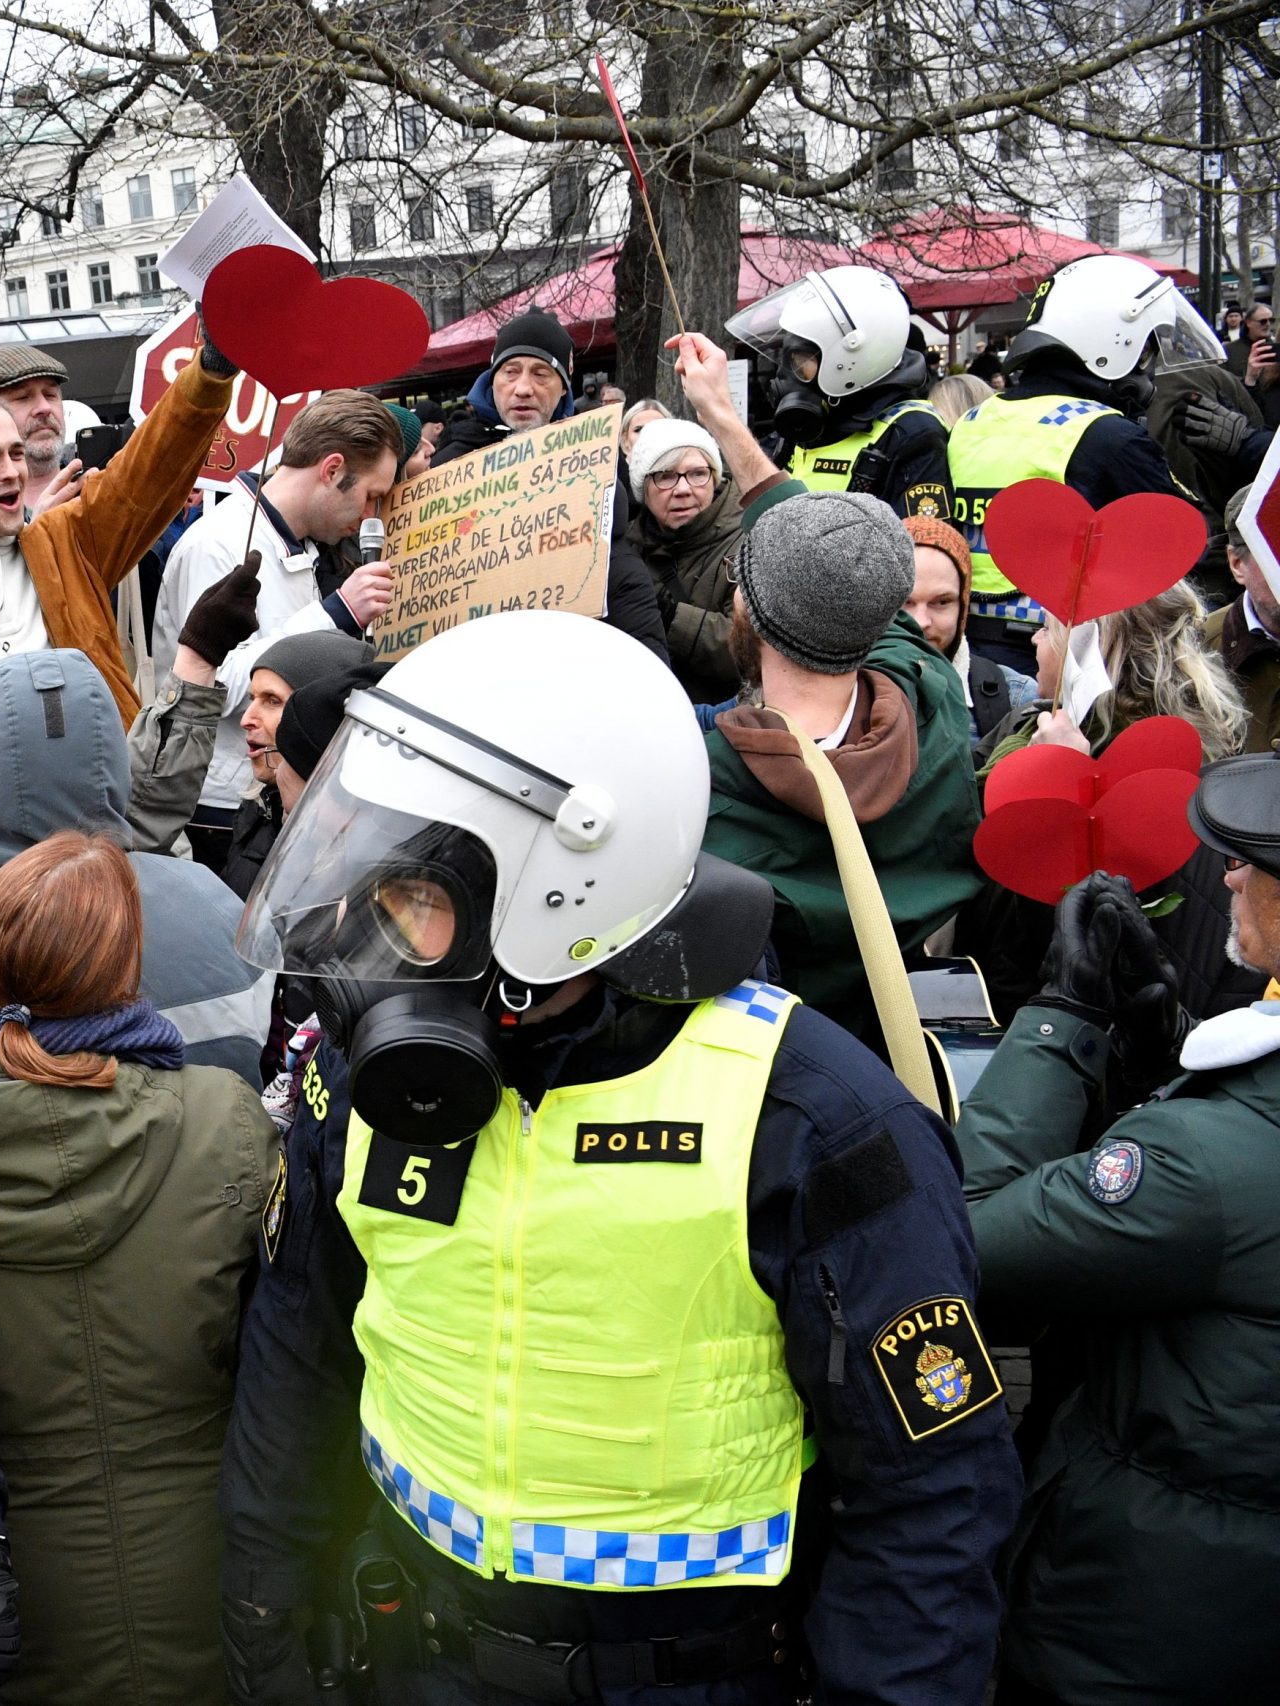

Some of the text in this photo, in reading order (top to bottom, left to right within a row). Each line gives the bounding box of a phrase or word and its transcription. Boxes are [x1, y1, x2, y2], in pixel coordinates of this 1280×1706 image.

[389, 415, 614, 513] LEVERERAR MEDIA SANNING
[815, 460, 848, 472] POLIS
[386, 446, 612, 537] OCH UPPLYSNING SÅ FÖDER
[908, 486, 942, 498] POLIS
[954, 498, 968, 522] D
[385, 517, 467, 560] DE LJUSET
[390, 537, 461, 581] EVERERAR
[471, 527, 491, 552] DE
[499, 503, 571, 543] LÖGNER
[411, 546, 510, 596] PROPAGANDA
[514, 535, 533, 561] SÅ
[539, 520, 593, 555] FÖDER
[375, 608, 394, 631] DE
[397, 579, 477, 622] MÖRKRET
[373, 620, 429, 657] VILKET
[302, 1060, 330, 1121] 535
[581, 1131, 696, 1153] POLIS
[397, 1155, 432, 1206] 5
[880, 1305, 960, 1357] POLIS
